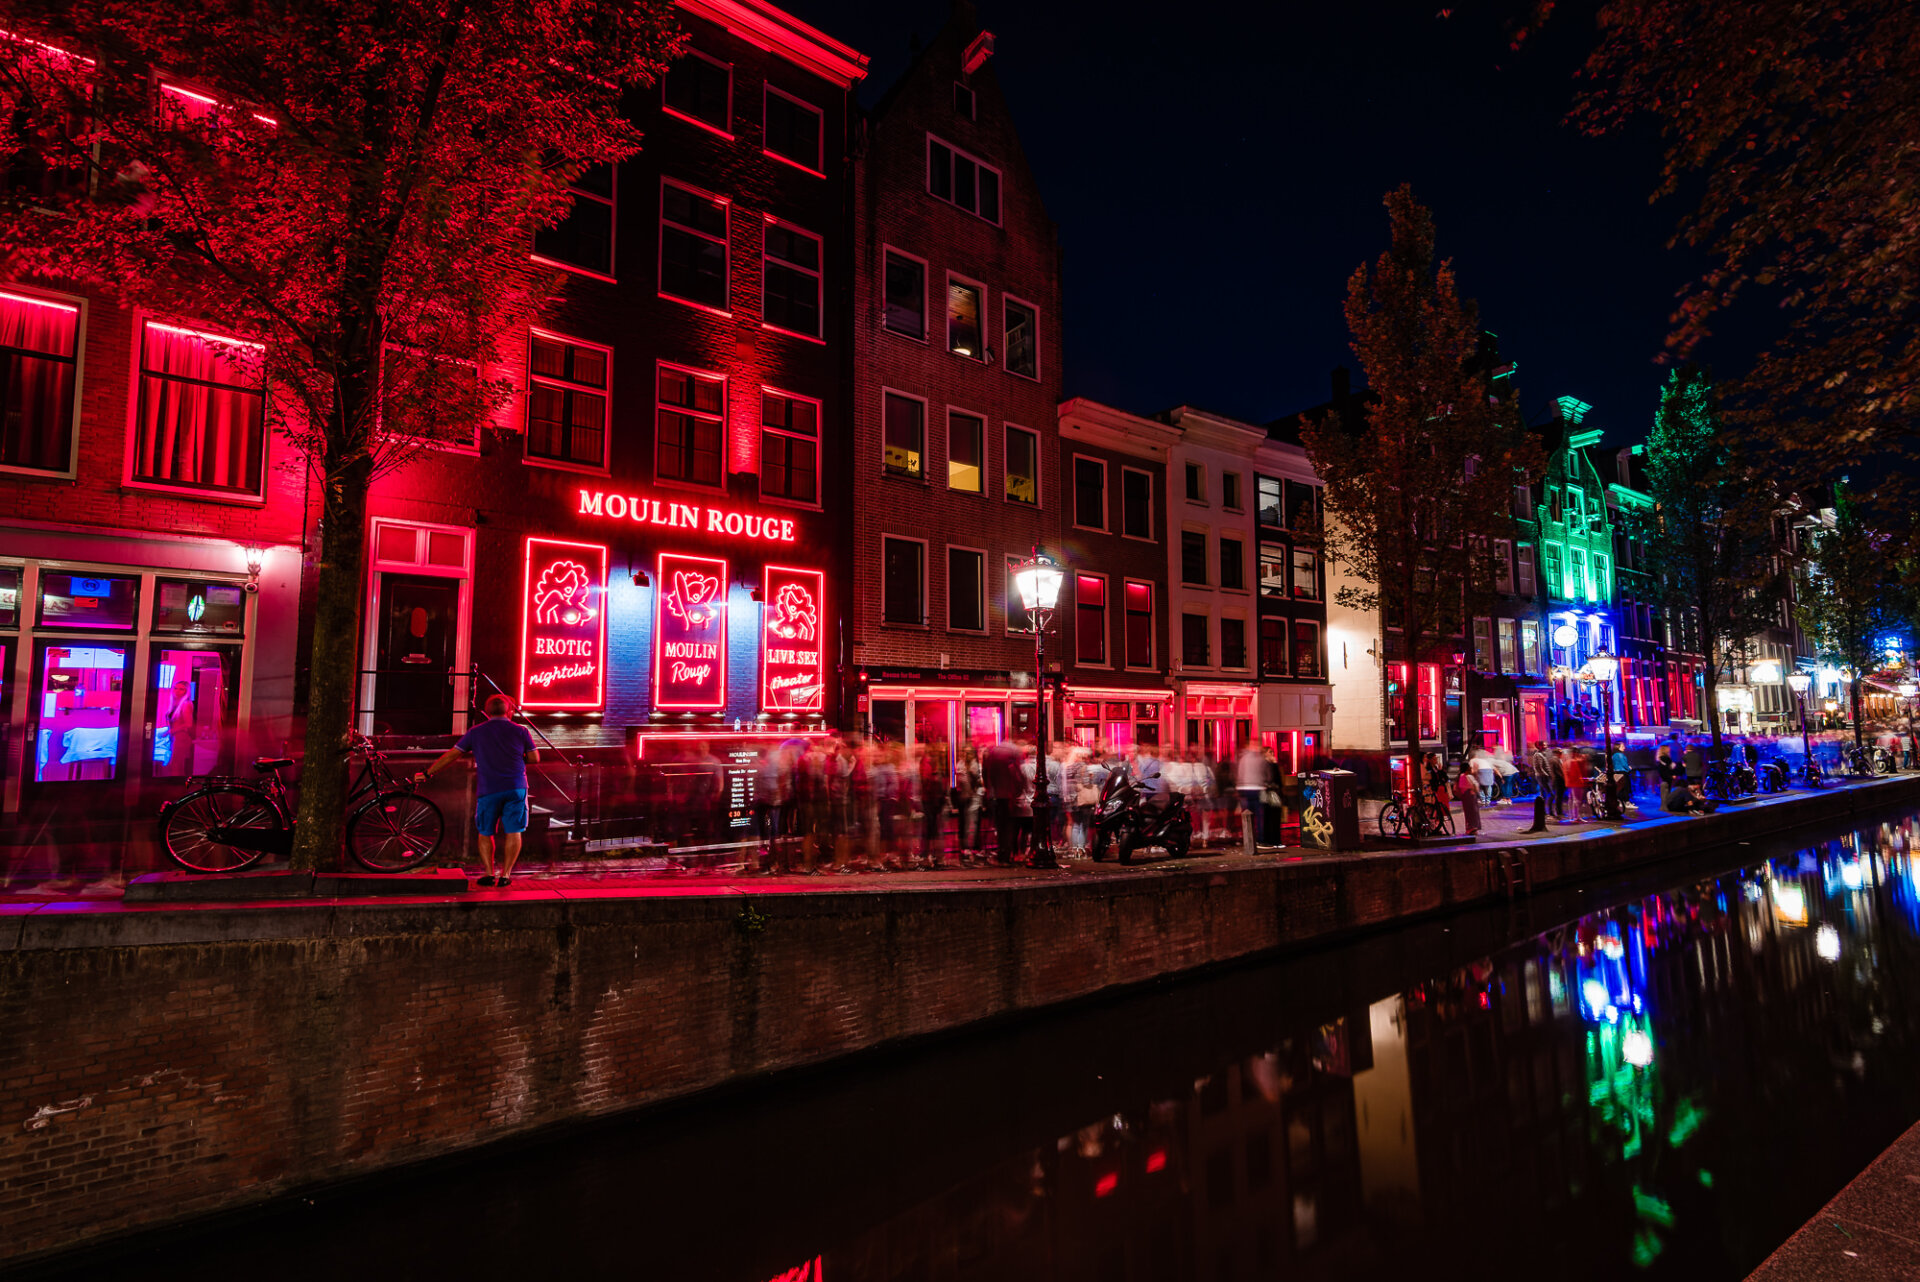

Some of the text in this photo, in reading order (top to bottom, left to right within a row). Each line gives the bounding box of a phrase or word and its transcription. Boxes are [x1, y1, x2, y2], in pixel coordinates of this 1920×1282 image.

[579, 490, 794, 541] MOULIN ROUGE
[535, 637, 592, 656] EROTIC
[665, 641, 717, 659] MOULIN
[767, 649, 818, 665] LIVE SEX
[529, 661, 596, 687] nightclub
[671, 661, 711, 685] Rouge
[770, 672, 814, 690] theater
